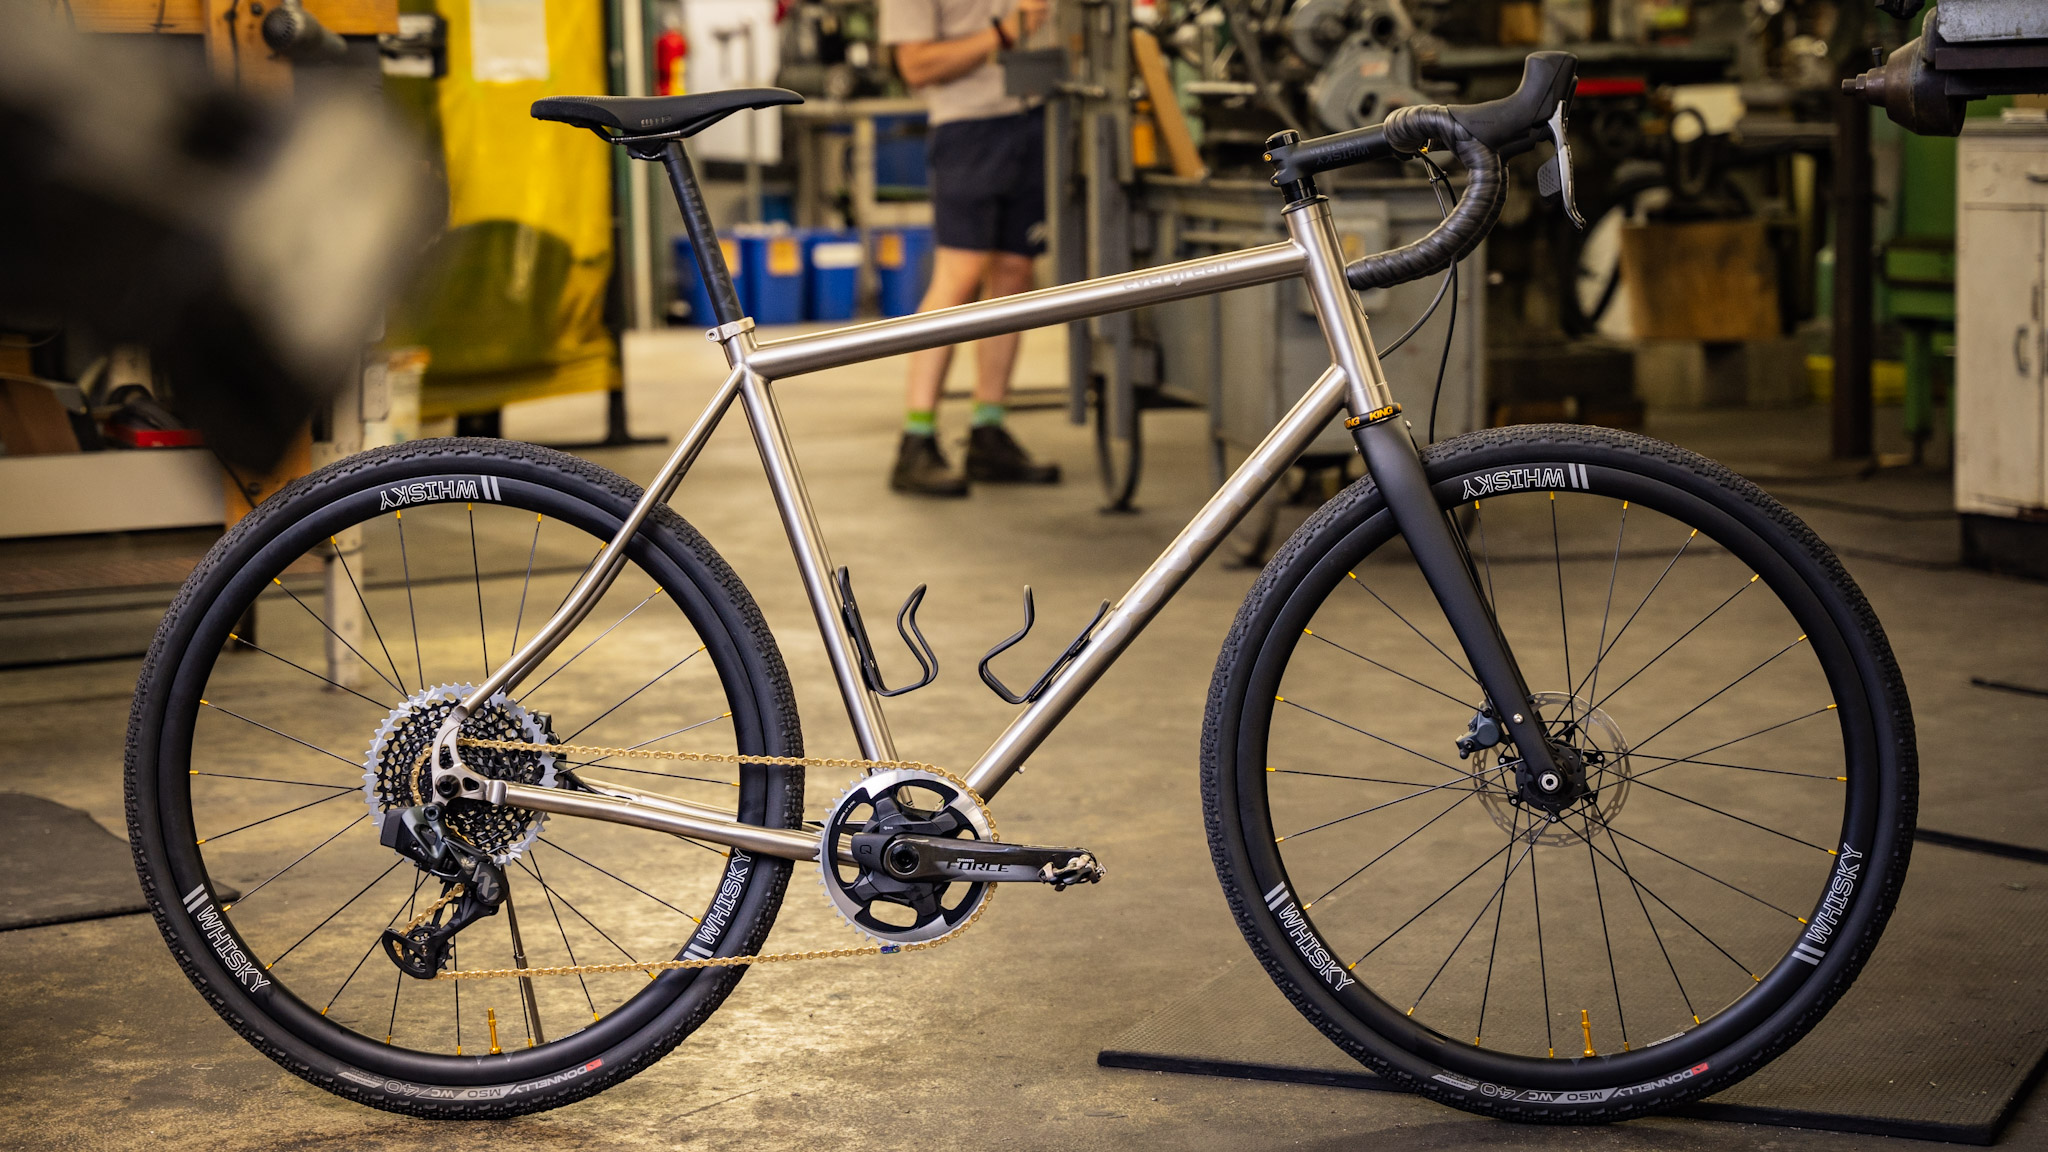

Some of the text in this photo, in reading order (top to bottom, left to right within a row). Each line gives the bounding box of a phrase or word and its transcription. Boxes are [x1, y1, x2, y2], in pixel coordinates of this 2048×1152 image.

[1369, 406, 1394, 421] KING
[380, 480, 479, 511] WHISKY
[1463, 468, 1565, 500] WHISKY
[946, 861, 1011, 873] FORCE
[696, 848, 751, 945] WHISKY
[1805, 842, 1863, 945] WHISKY
[197, 904, 271, 993] WHISKY
[1279, 902, 1355, 992] WHISKY
[384, 1079, 419, 1097] 40
[430, 1088, 455, 1099] WC
[467, 1088, 501, 1099] MSO
[511, 1064, 588, 1095] DONNELLY
[1480, 1069, 1694, 1101] DONNELLY MSO WC 40
